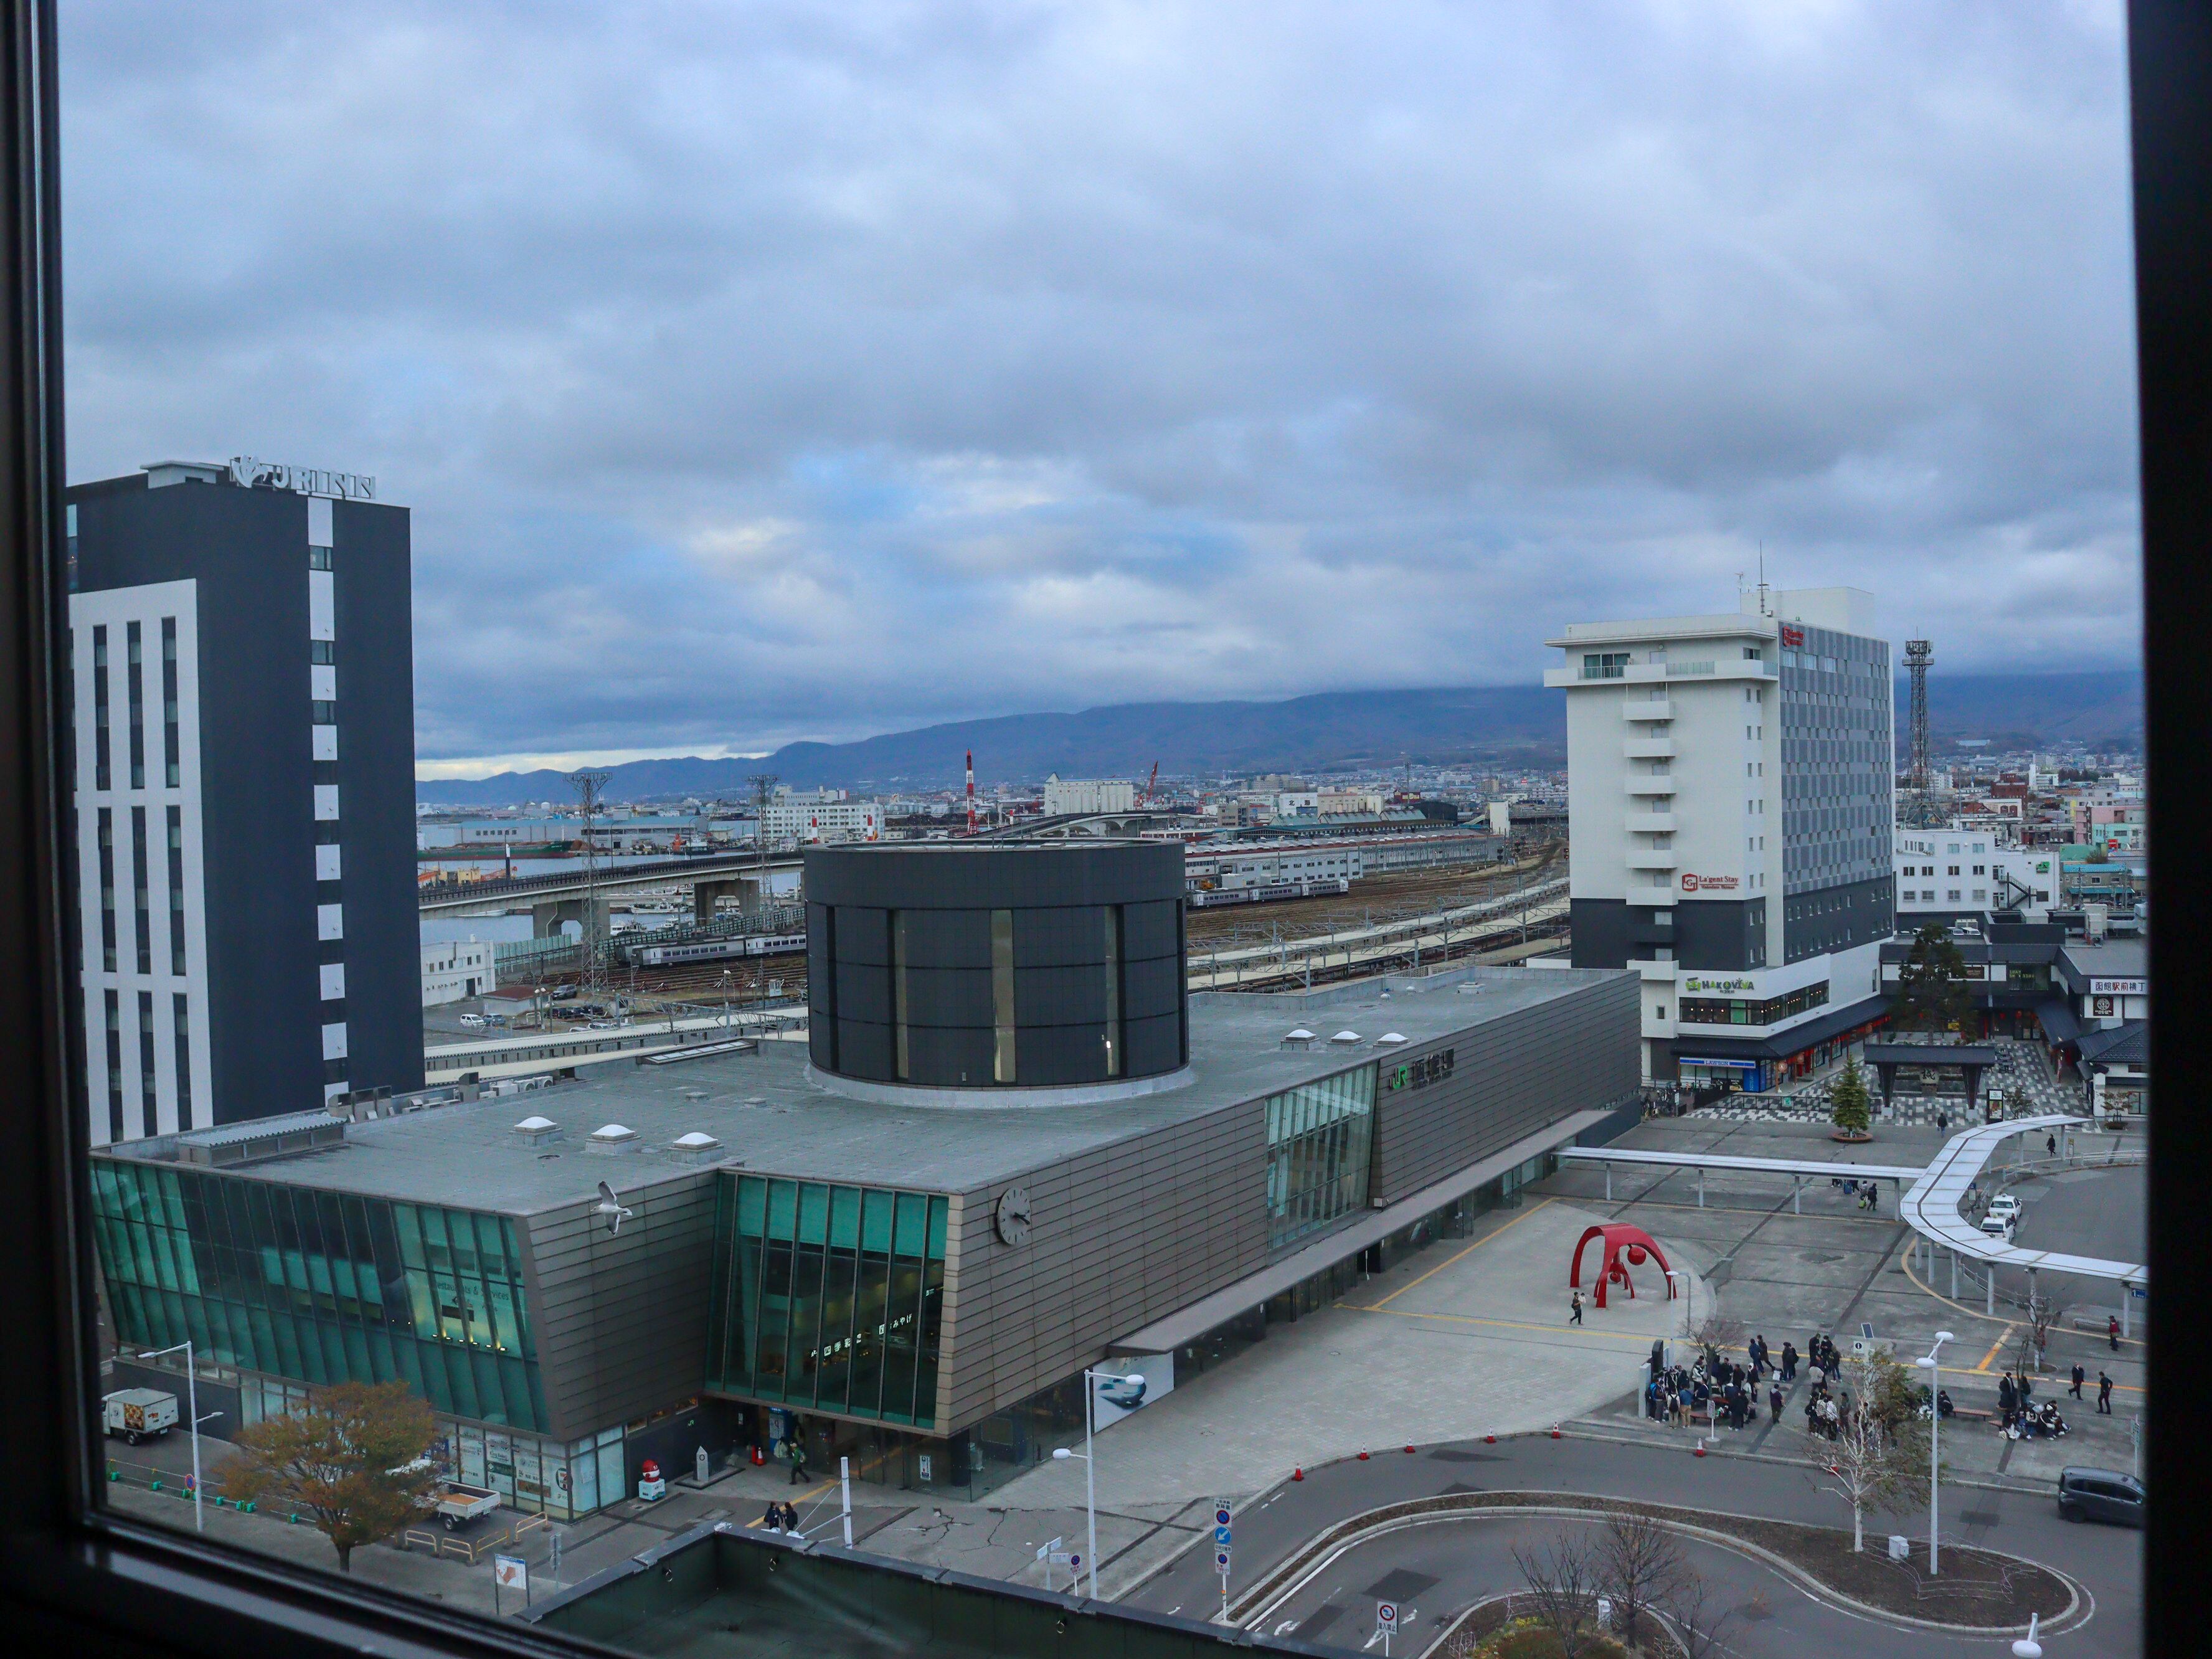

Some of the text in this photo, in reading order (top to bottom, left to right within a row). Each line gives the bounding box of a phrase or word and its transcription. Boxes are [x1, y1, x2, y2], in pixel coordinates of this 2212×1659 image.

[2095, 981, 2146, 991] 函館駅前横丁
[1391, 1065, 1408, 1090] JR
